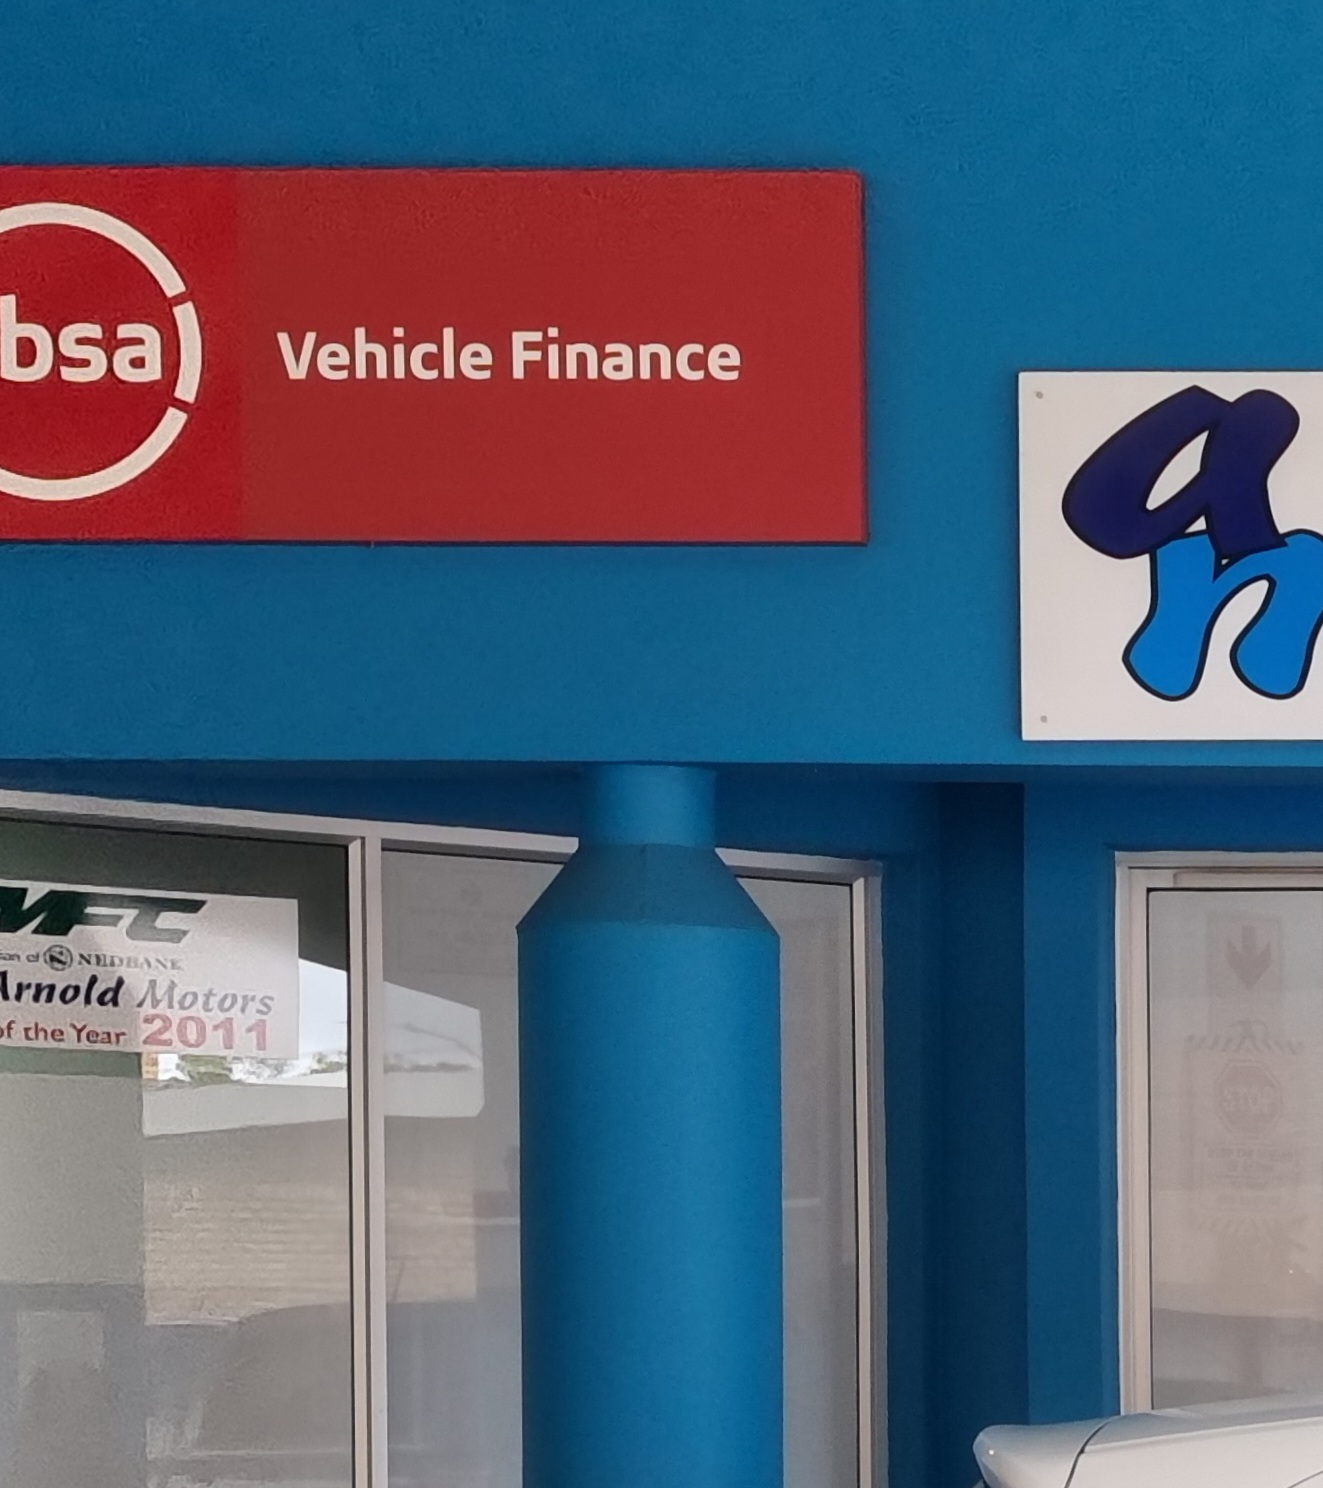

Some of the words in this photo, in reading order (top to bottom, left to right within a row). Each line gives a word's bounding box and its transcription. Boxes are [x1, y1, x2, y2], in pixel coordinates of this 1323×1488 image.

[277, 327, 493, 381] Vehicle
[511, 327, 742, 381] Finance
[136, 978, 275, 1017] Motors
[23, 1021, 65, 1043] the
[70, 1022, 127, 1044] Year
[142, 1012, 268, 1051] 2011
